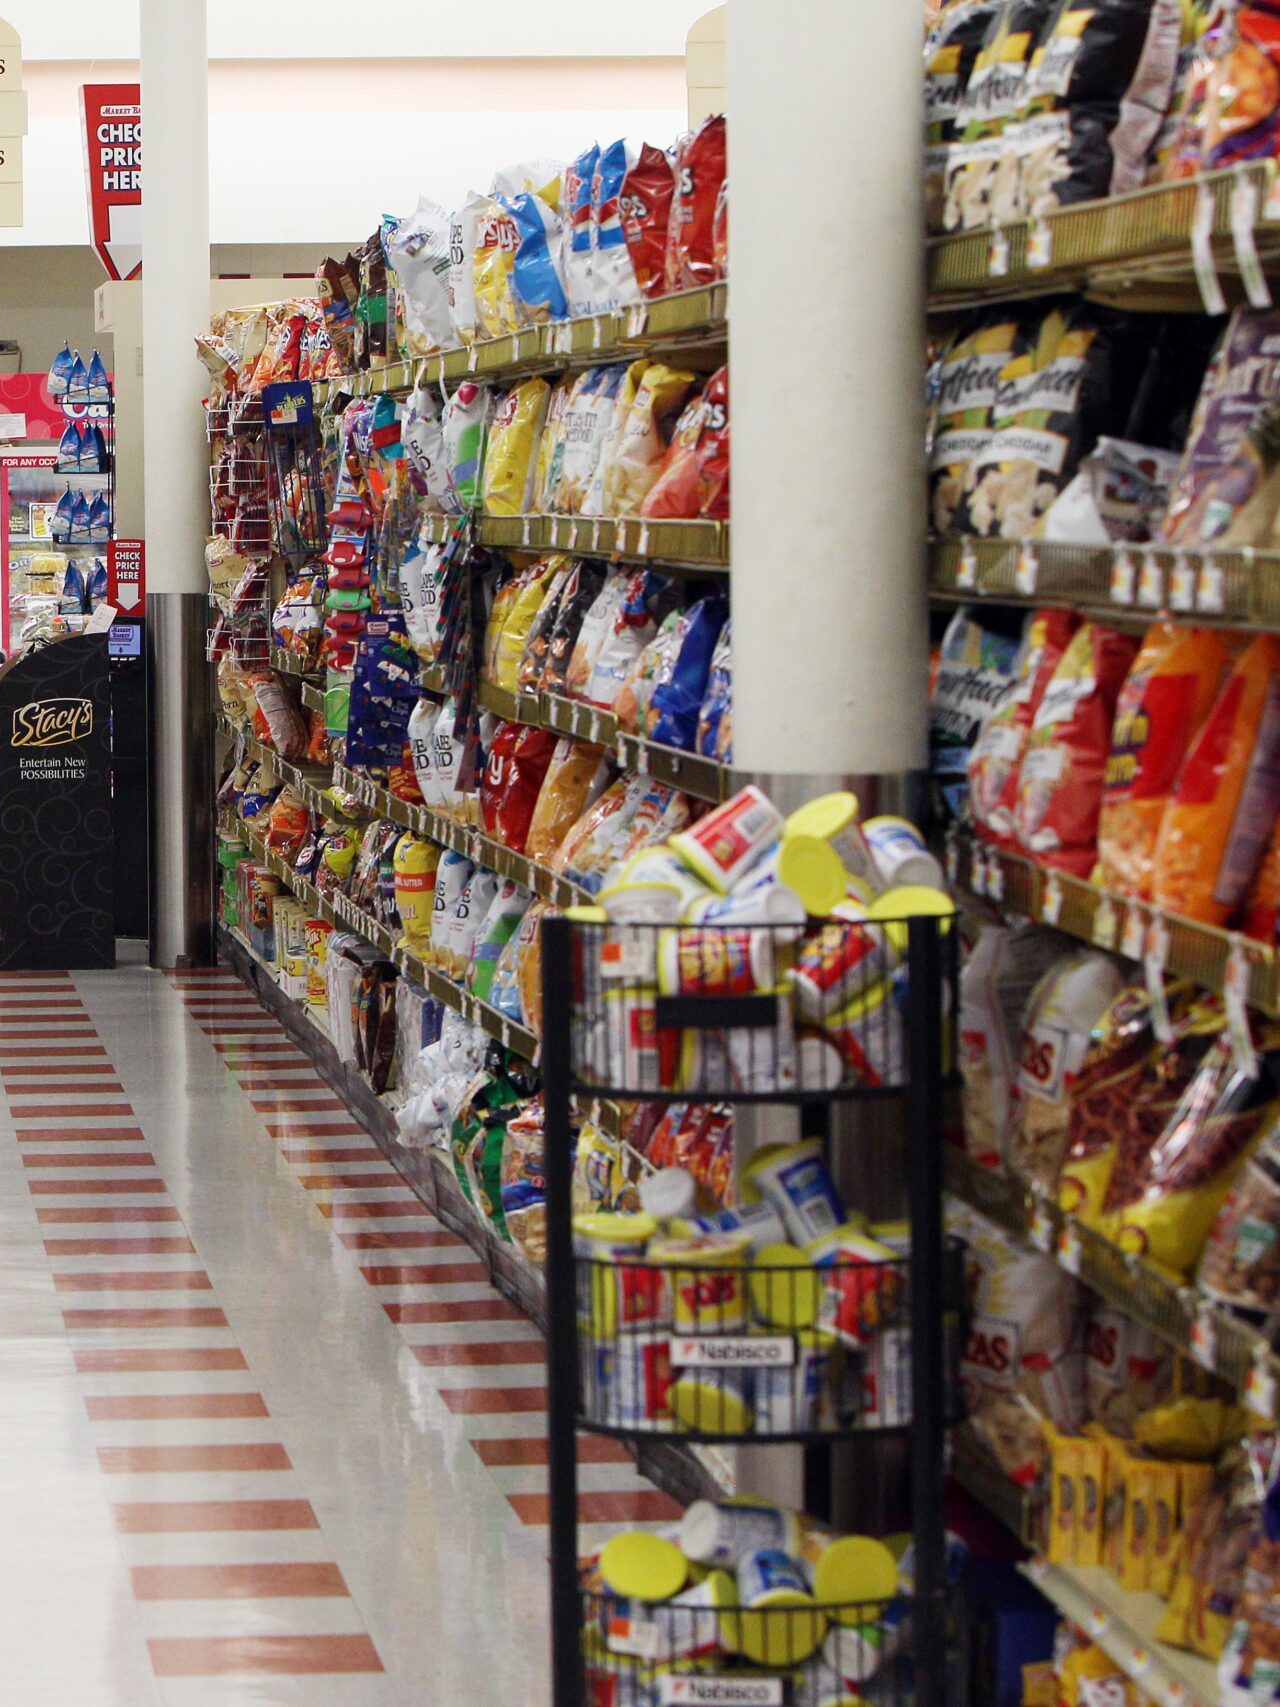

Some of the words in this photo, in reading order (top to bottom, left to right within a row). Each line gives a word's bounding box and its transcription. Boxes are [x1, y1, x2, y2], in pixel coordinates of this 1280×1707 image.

[97, 122, 141, 144] CHEC
[100, 147, 141, 168] PRIC
[103, 170, 141, 191] HER
[2, 458, 19, 466] FOR
[20, 458, 38, 466] ANY
[115, 552, 140, 560] CHECK
[116, 562, 140, 570] PRICE
[116, 572, 139, 580] HERE
[11, 701, 93, 747] Stacy's
[20, 757, 61, 768] Entertain
[64, 757, 86, 767] New
[21, 768, 85, 780] POSSIBILITIES
[699, 1343, 780, 1359] Nabisco
